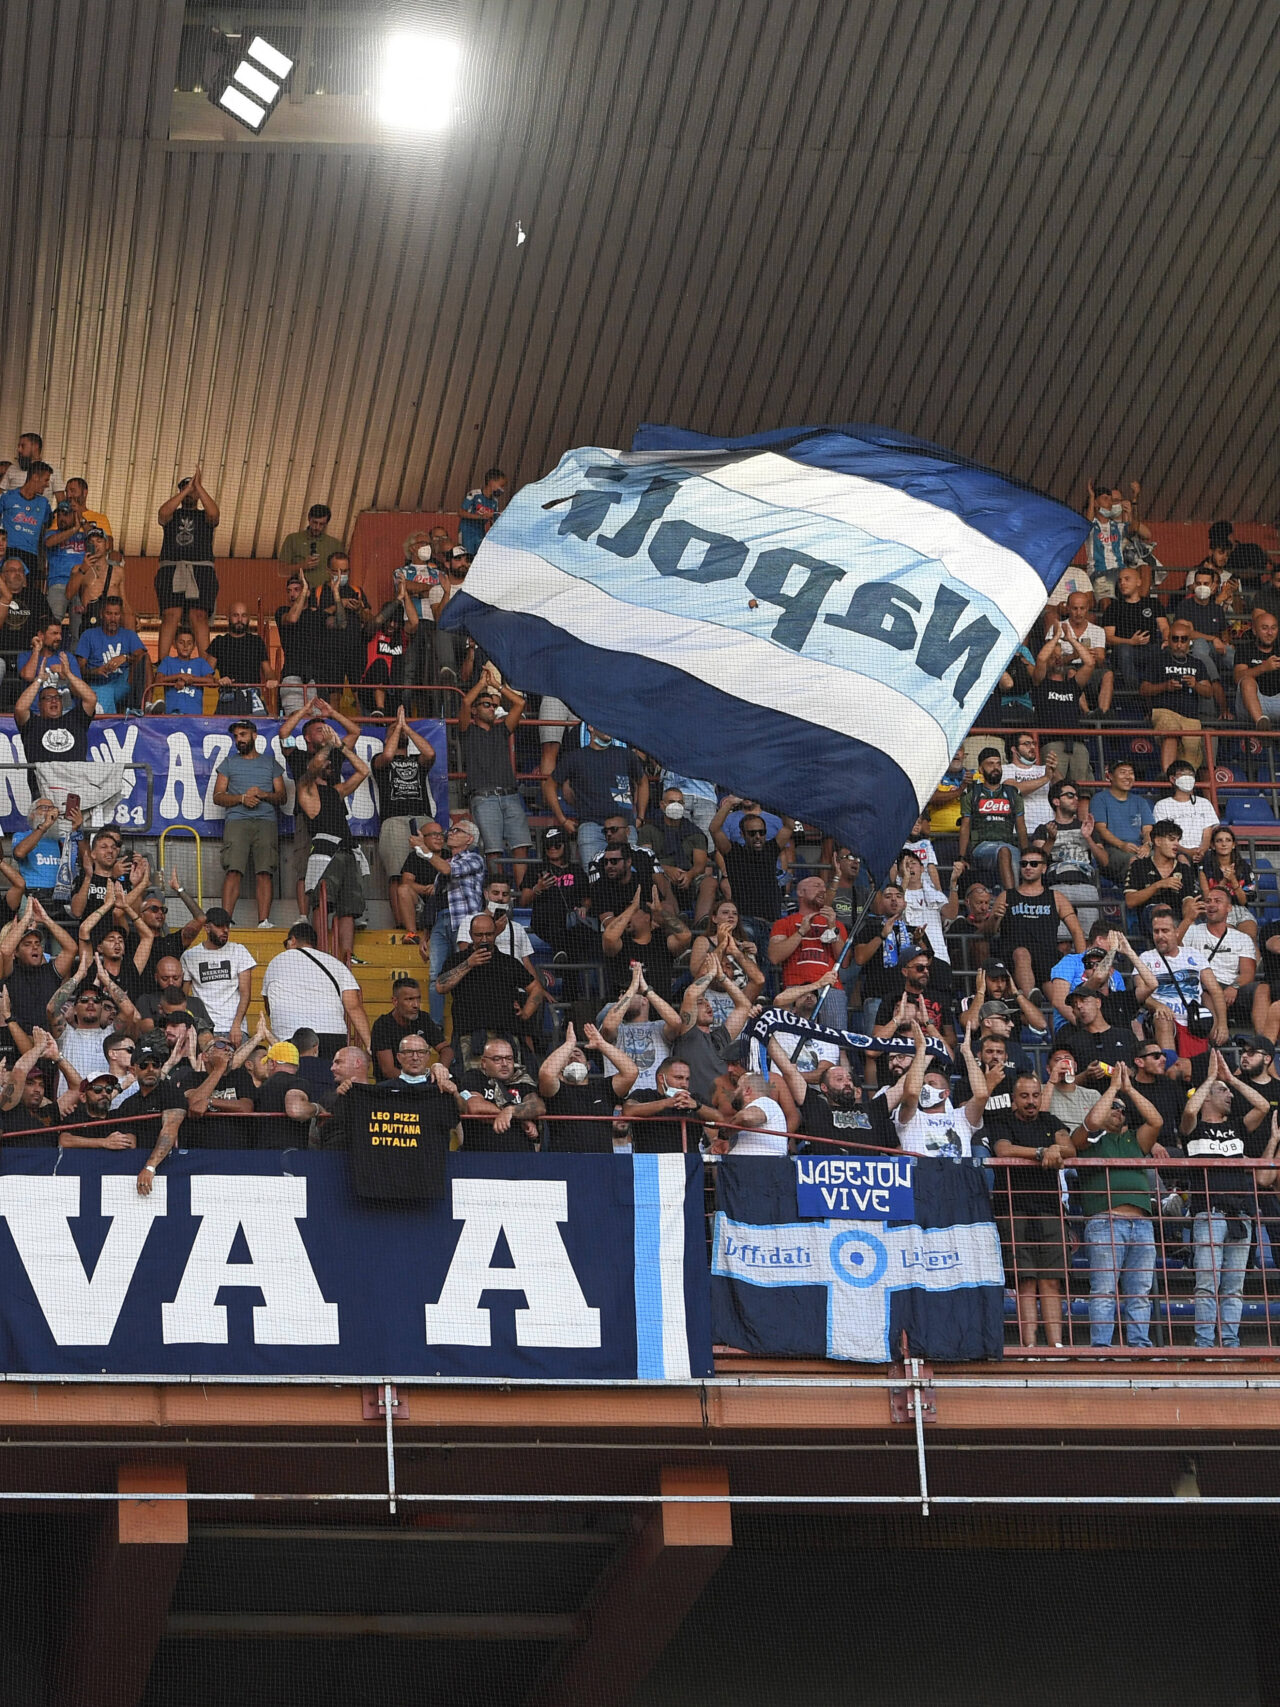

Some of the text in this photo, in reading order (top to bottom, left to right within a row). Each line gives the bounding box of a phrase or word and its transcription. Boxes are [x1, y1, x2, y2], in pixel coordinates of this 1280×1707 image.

[978, 800, 1011, 812] Lete
[1011, 902, 1051, 916] ultras
[202, 969, 229, 977] WEEKEND
[202, 973, 230, 982] OFFENDER
[754, 1007, 841, 1038] BRIGATA
[371, 1111, 420, 1122] LEO PIZZI
[369, 1122, 421, 1135] LA PUTTANA
[371, 1136, 418, 1148] D'ITALIA
[1209, 1142, 1238, 1153] CLUB
[821, 1187, 890, 1212] VIVE
[425, 1178, 602, 1348] A
